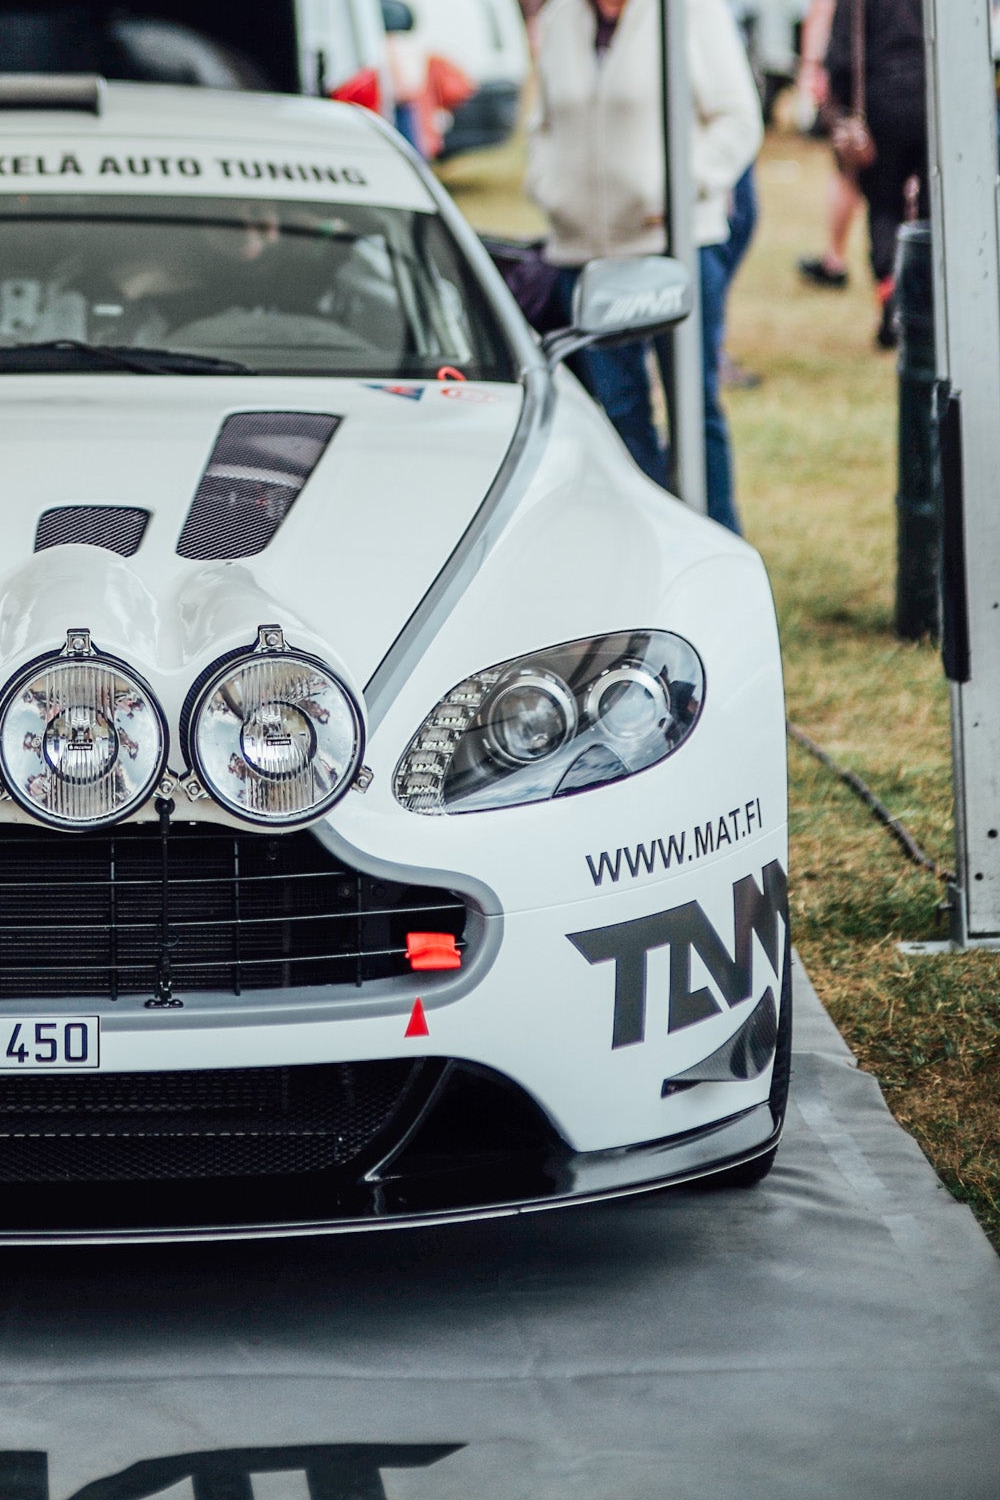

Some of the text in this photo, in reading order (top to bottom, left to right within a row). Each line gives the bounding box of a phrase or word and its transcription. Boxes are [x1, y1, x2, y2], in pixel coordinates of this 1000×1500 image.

[99, 156, 201, 177] AUTO
[214, 158, 368, 186] TUNING
[585, 797, 763, 887] WWW.MAT.FI
